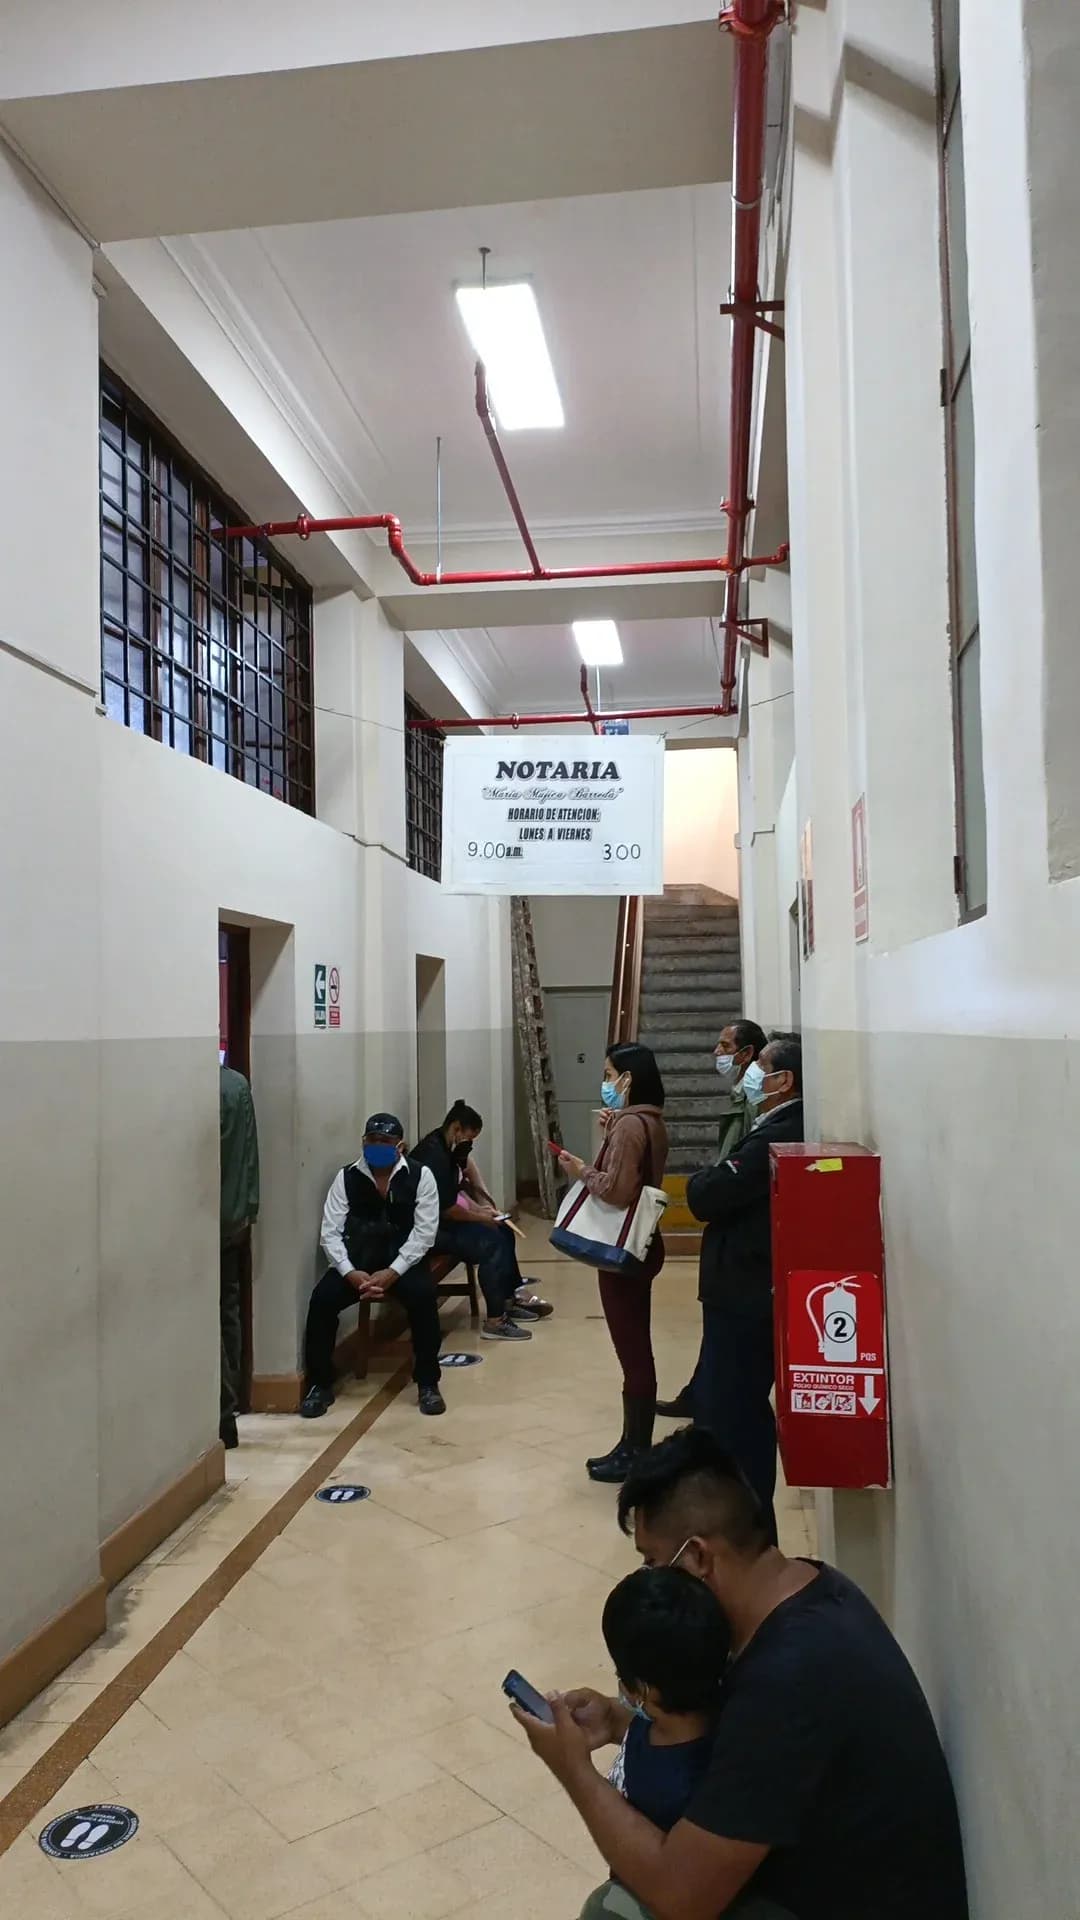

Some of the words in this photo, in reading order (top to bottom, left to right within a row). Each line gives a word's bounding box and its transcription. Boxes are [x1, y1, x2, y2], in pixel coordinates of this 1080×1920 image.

[495, 760, 621, 780] NOTARIA
[507, 808, 545, 820] HORARIO
[545, 808, 557, 820] DE
[519, 828, 545, 840] LUNES
[547, 828, 554, 840] A
[557, 828, 592, 840] VIERNES
[833, 1317, 847, 1338] 2
[860, 1352, 877, 1361] PQS
[793, 1372, 855, 1385] EXTINTOR
